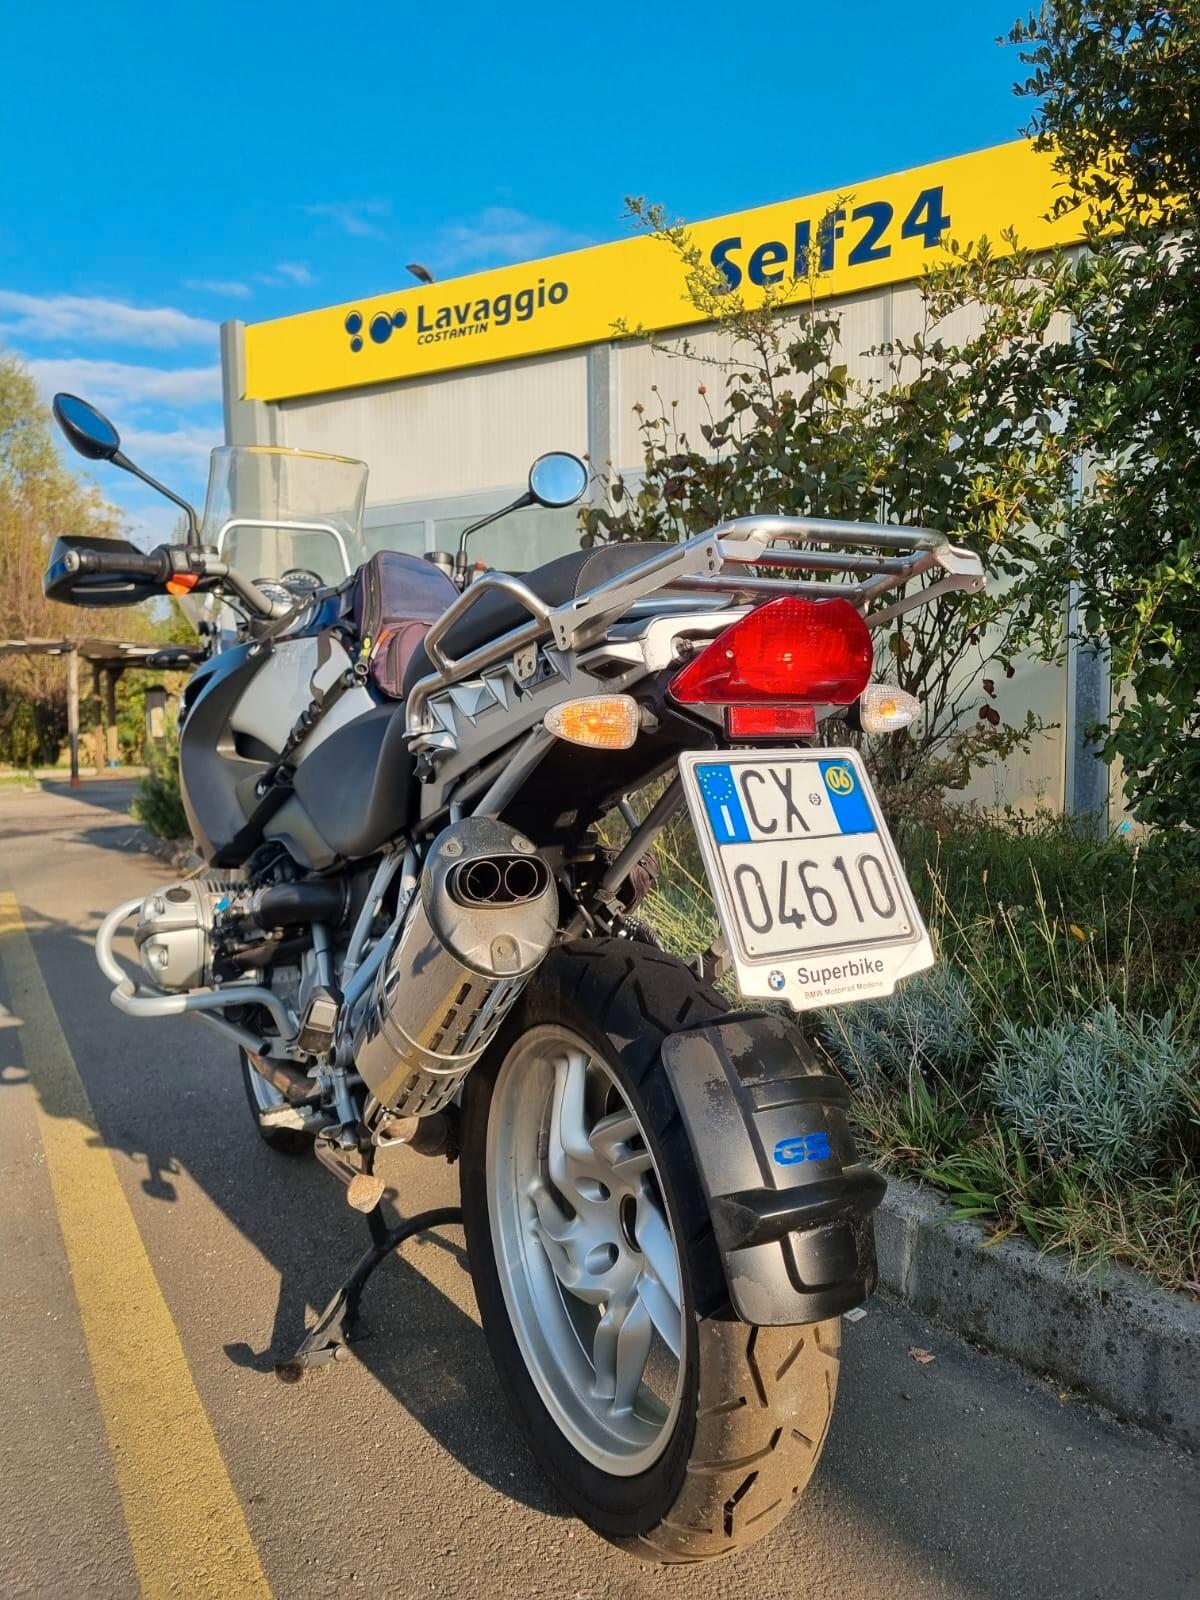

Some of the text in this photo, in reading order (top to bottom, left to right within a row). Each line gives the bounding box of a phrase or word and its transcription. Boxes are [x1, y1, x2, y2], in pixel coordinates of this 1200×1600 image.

[710, 186, 951, 296] Self24
[416, 278, 568, 333] Lavaggio
[417, 322, 488, 345] COSTANTIN
[828, 768, 850, 788] 06
[739, 768, 811, 834] CX
[733, 853, 897, 934] 04610
[797, 958, 884, 985] Superbike
[805, 991, 823, 999] BMW
[825, 985, 855, 995] Motorrad
[774, 1131, 831, 1164] GS
